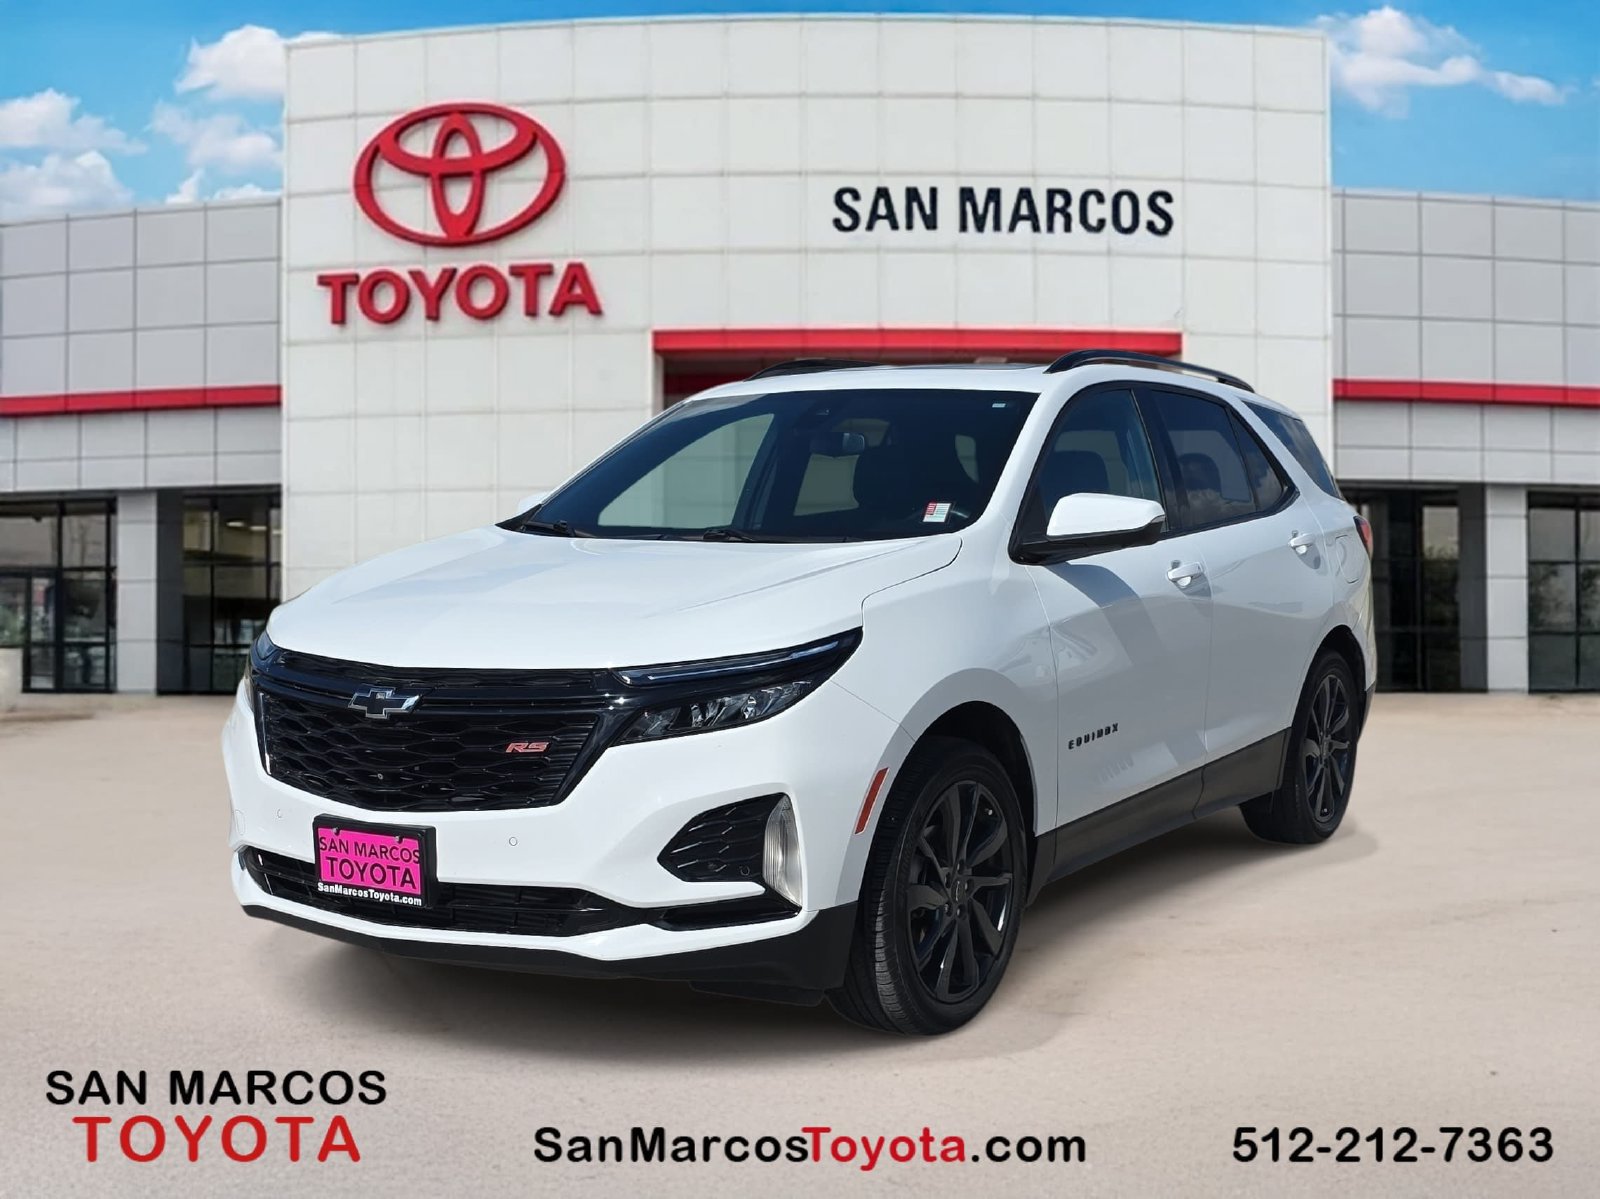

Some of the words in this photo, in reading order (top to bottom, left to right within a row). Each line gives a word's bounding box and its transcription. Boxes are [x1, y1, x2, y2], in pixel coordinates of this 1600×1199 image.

[833, 187, 937, 232] SAN
[960, 188, 1174, 236] MARCOS
[318, 262, 602, 324] TOYOTA
[505, 741, 550, 753] RS
[1068, 722, 1119, 750] EQUINOX
[319, 836, 349, 855] SAN
[354, 842, 420, 864] MARCOS
[326, 856, 417, 890] TOYOTA
[317, 882, 422, 906] SanMarcosToyota.com
